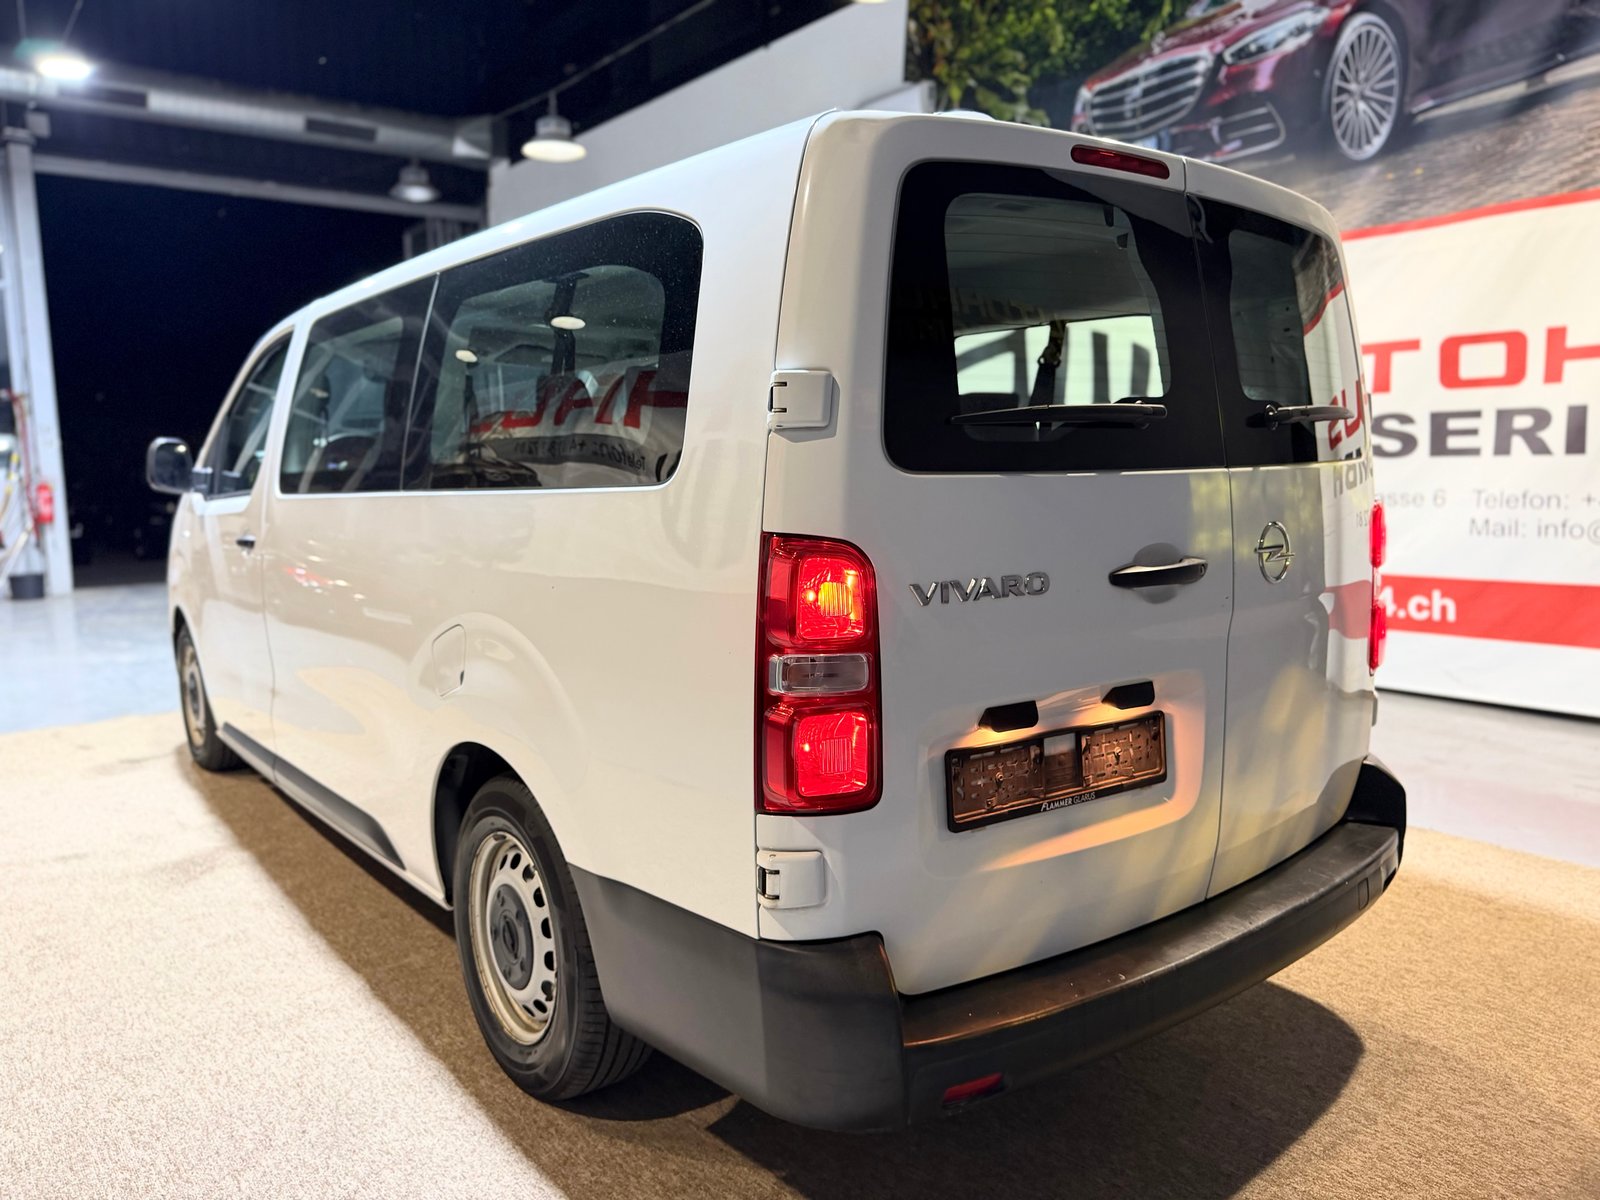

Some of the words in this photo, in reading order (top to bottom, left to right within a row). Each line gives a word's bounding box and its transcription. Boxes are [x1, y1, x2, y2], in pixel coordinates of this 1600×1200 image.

[1371, 404, 1588, 459] SERI
[1433, 487, 1448, 510] 6
[1472, 488, 1569, 511] Telefon:
[1468, 517, 1527, 538] Mail:
[909, 571, 1050, 607] VIVARO
[1040, 797, 1073, 812] FLAMMER
[1073, 791, 1096, 804] GLARUS
